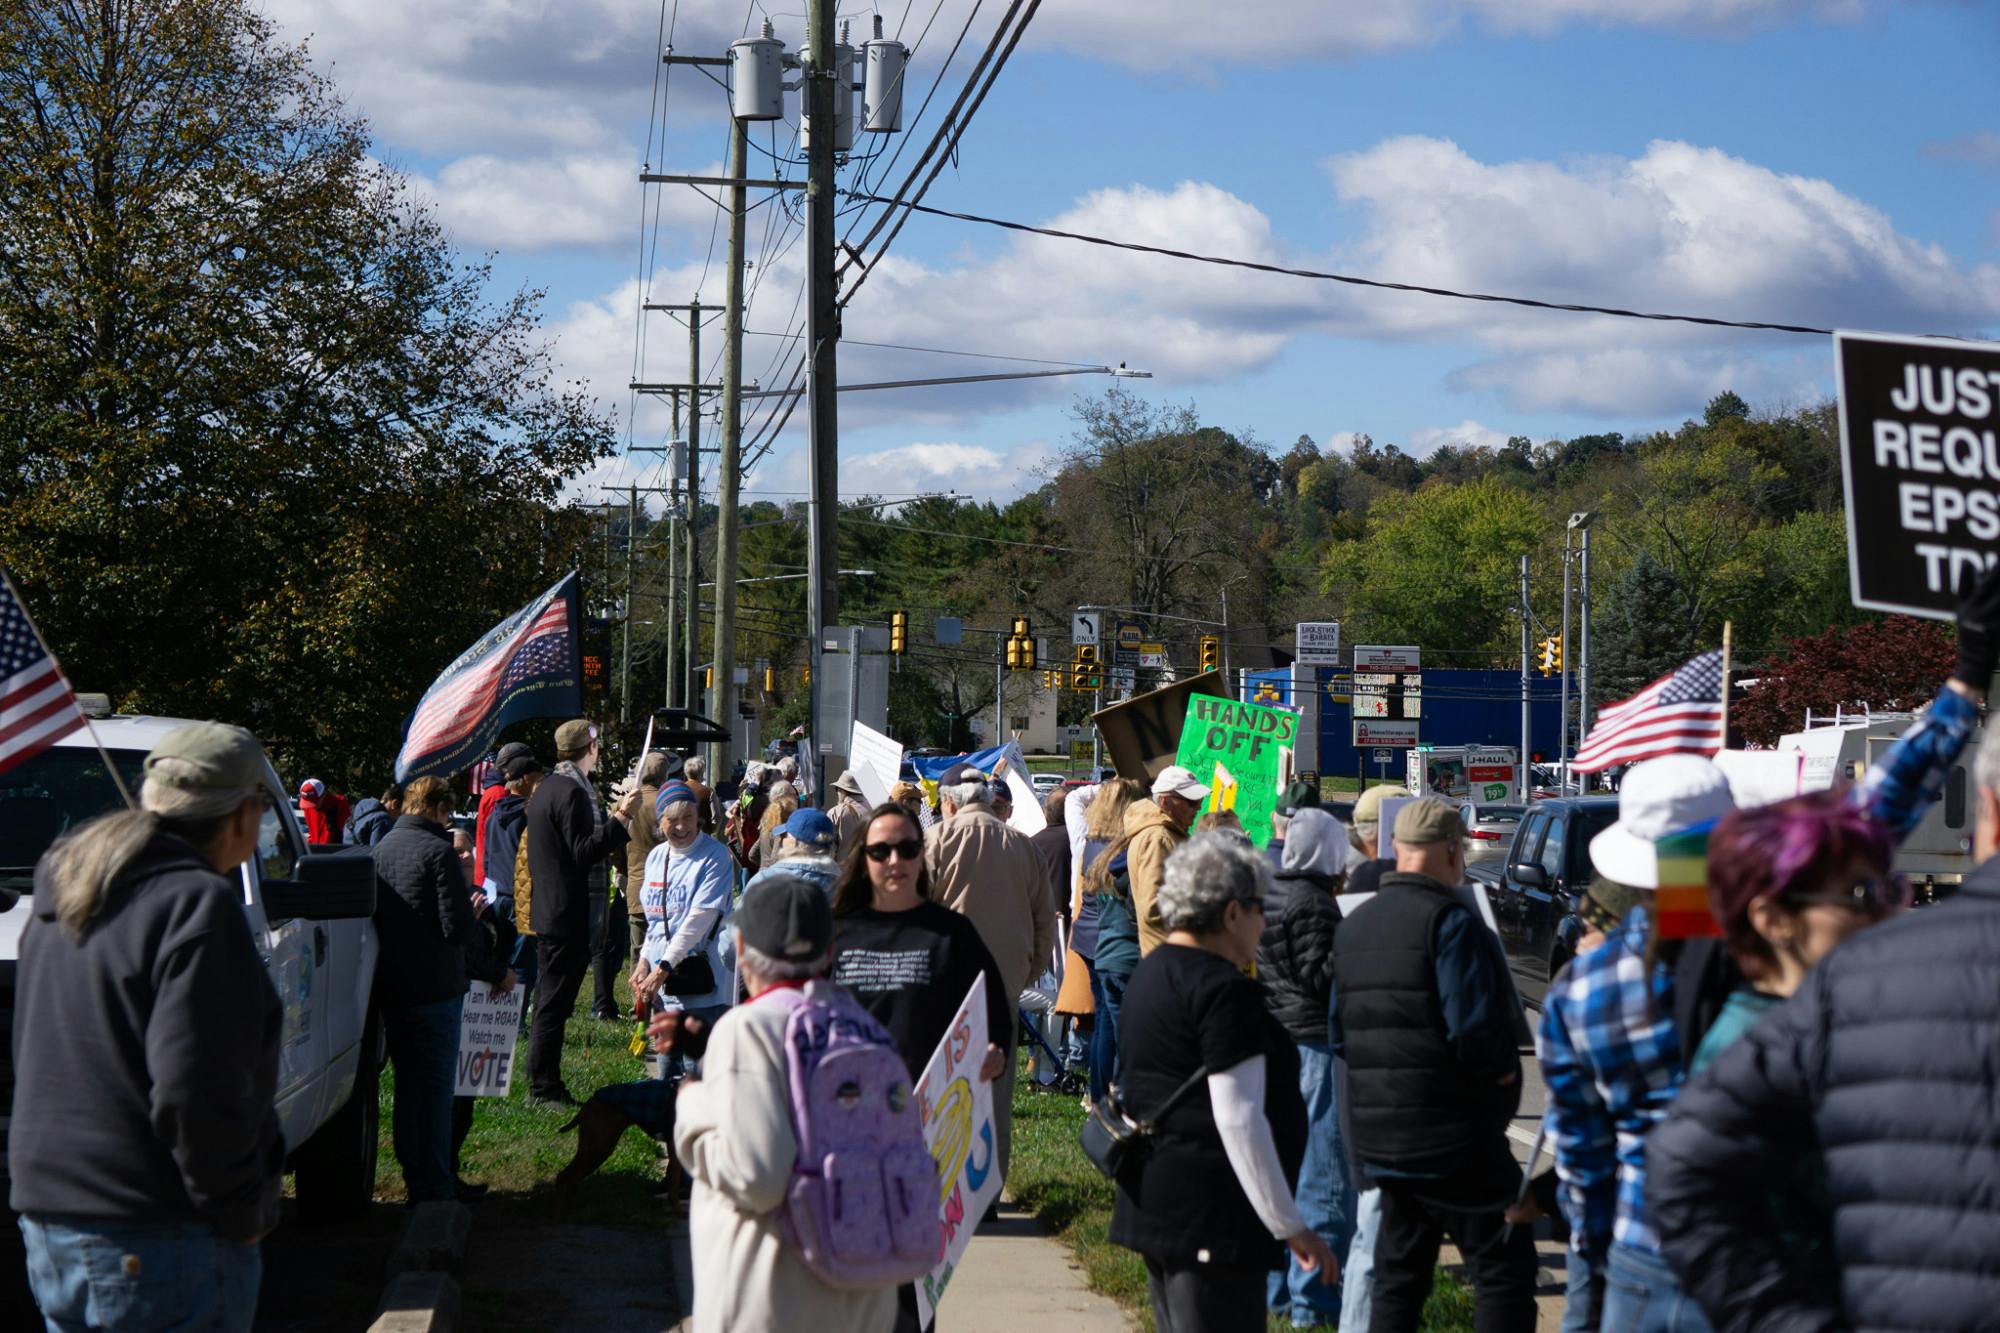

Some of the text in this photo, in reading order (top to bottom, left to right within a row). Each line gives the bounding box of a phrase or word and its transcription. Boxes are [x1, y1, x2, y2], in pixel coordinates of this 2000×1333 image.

[1195, 699, 1294, 741] HANDS
[1206, 726, 1270, 762] OFF
[472, 991, 484, 1004] am
[463, 1008, 480, 1024] Hear
[481, 1012, 493, 1025] me
[468, 1029, 506, 1046] Watch me
[458, 1051, 511, 1088] VOTE
